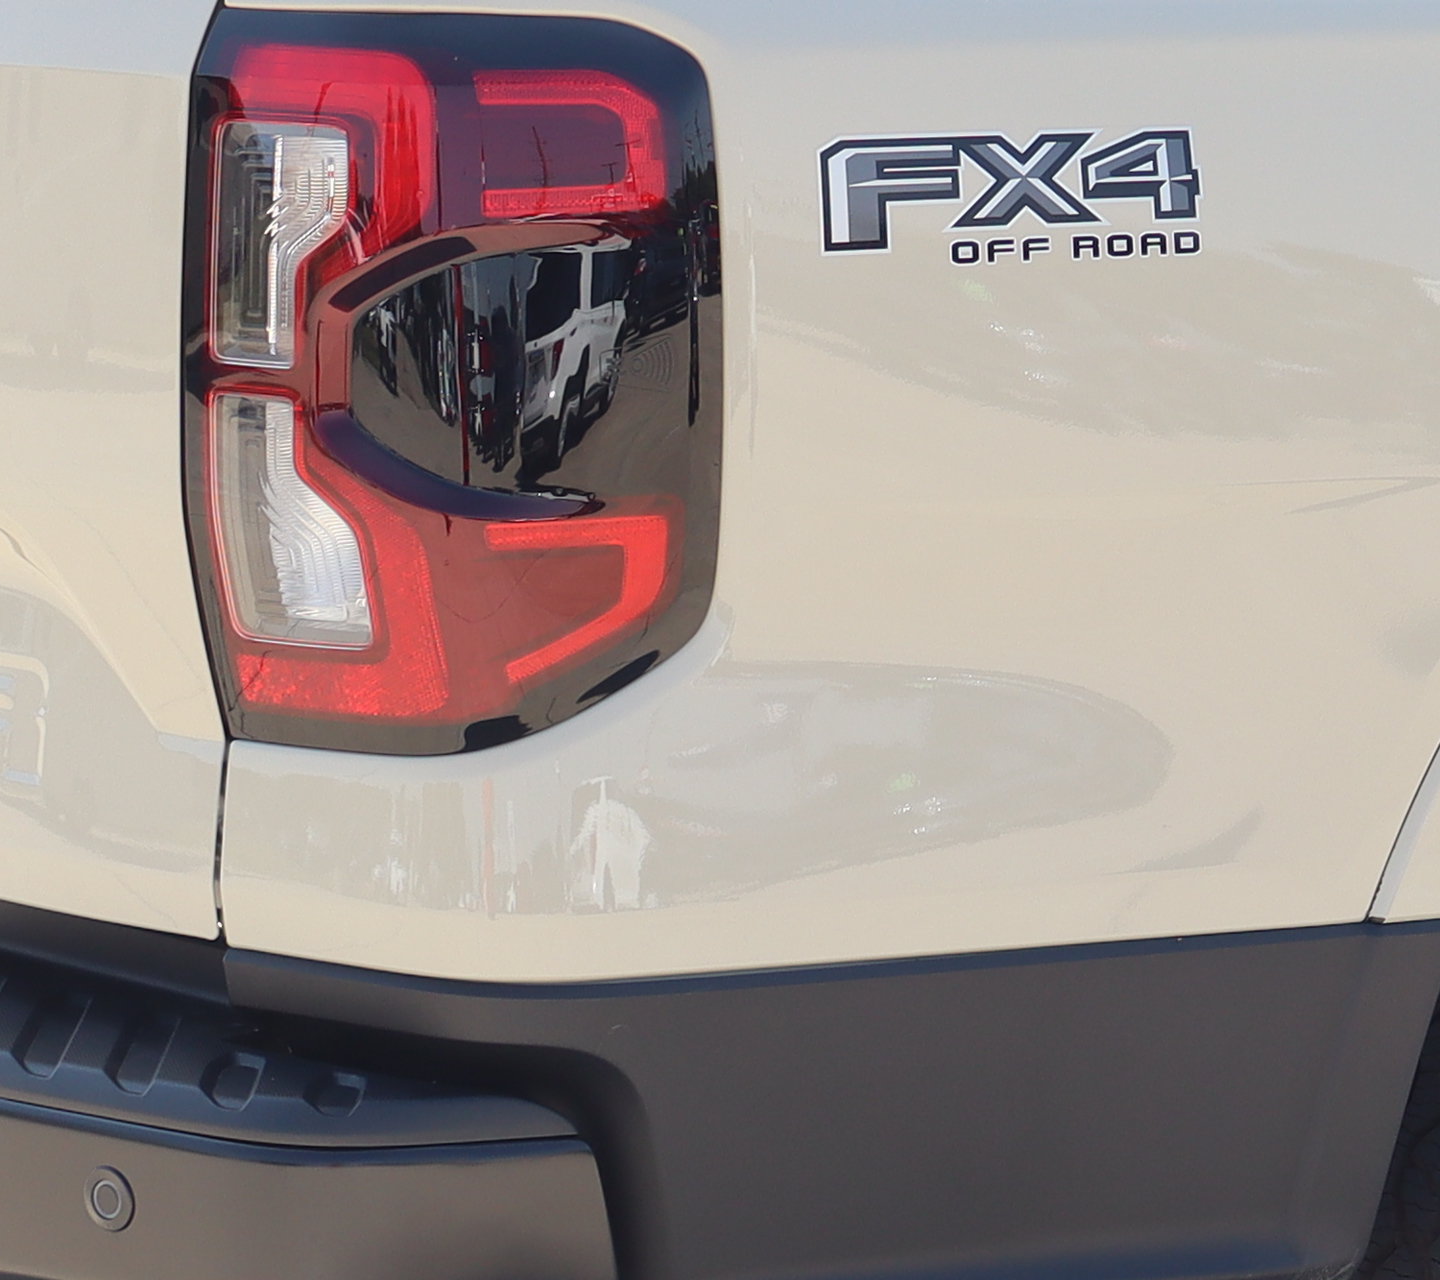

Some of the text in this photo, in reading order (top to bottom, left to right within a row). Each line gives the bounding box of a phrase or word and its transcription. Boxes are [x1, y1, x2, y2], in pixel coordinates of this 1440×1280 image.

[817, 126, 1203, 256] FX4
[950, 230, 1202, 266] OFF ROAD
